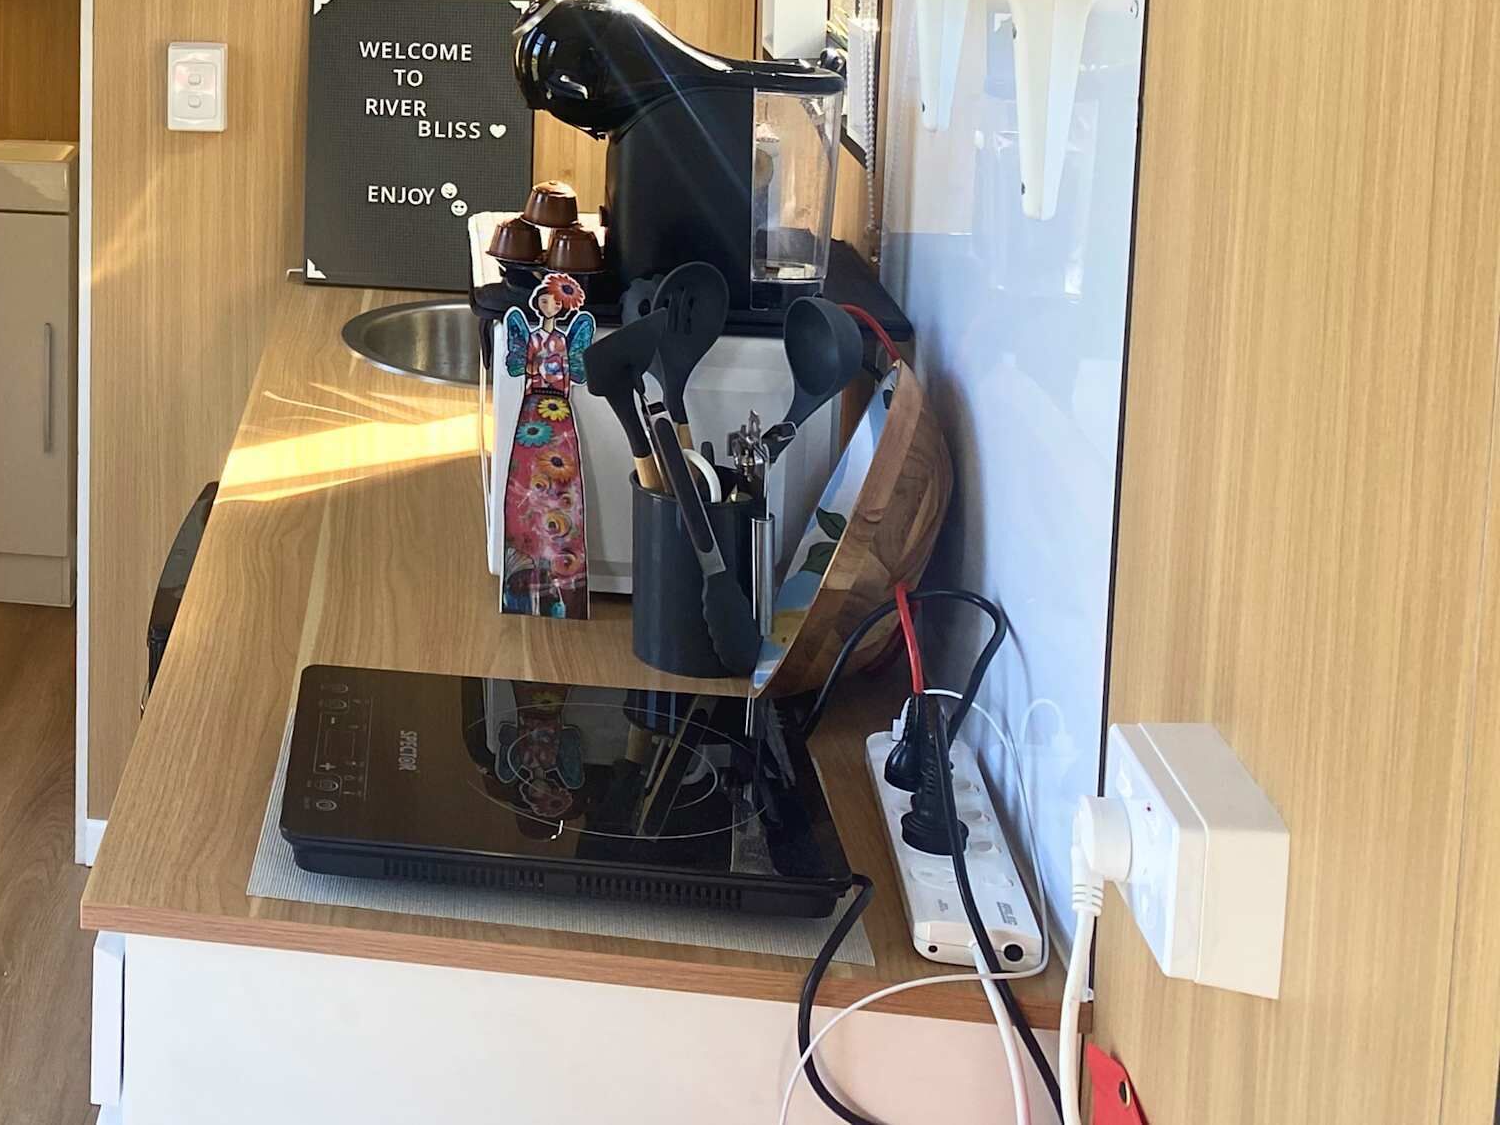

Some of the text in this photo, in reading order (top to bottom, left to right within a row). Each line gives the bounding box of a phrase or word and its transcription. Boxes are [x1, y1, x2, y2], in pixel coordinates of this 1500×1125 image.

[359, 41, 472, 61] WELCOME
[393, 69, 423, 87] TO
[365, 98, 427, 117] RIVER
[417, 121, 481, 139] BLISS
[368, 185, 435, 205] ENJOY
[398, 730, 419, 771] SPECTOR
